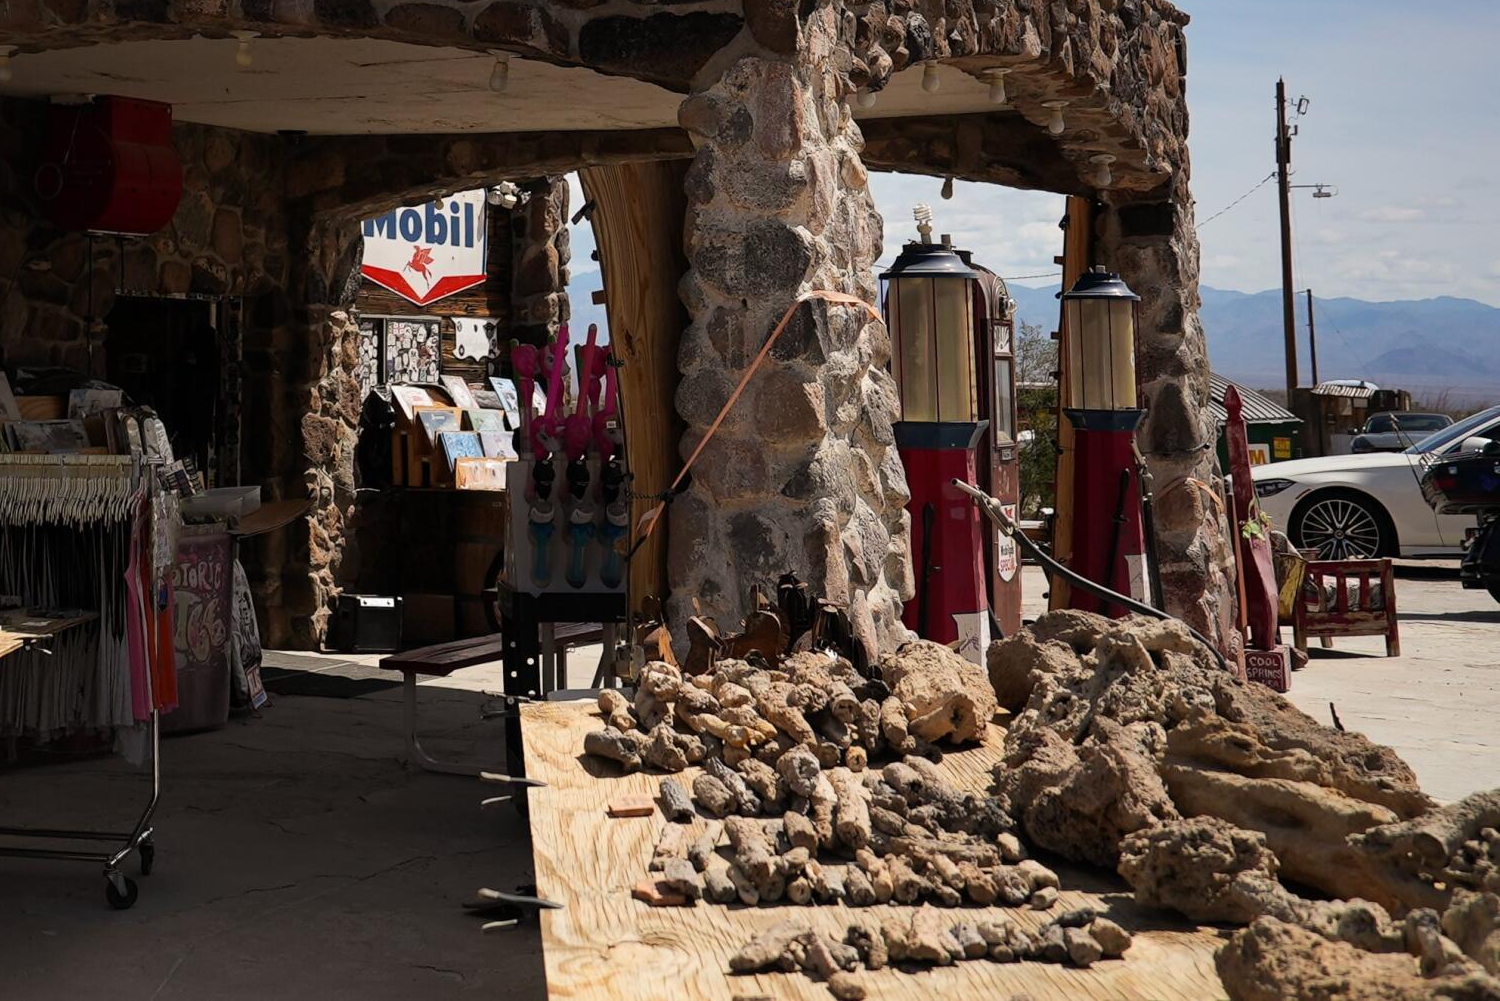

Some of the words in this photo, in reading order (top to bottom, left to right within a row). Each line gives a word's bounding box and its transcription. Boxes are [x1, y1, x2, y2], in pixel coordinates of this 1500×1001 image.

[363, 200, 474, 248] Mobil
[1248, 656, 1279, 667] COOL
[1246, 667, 1283, 679] SPRINGS
